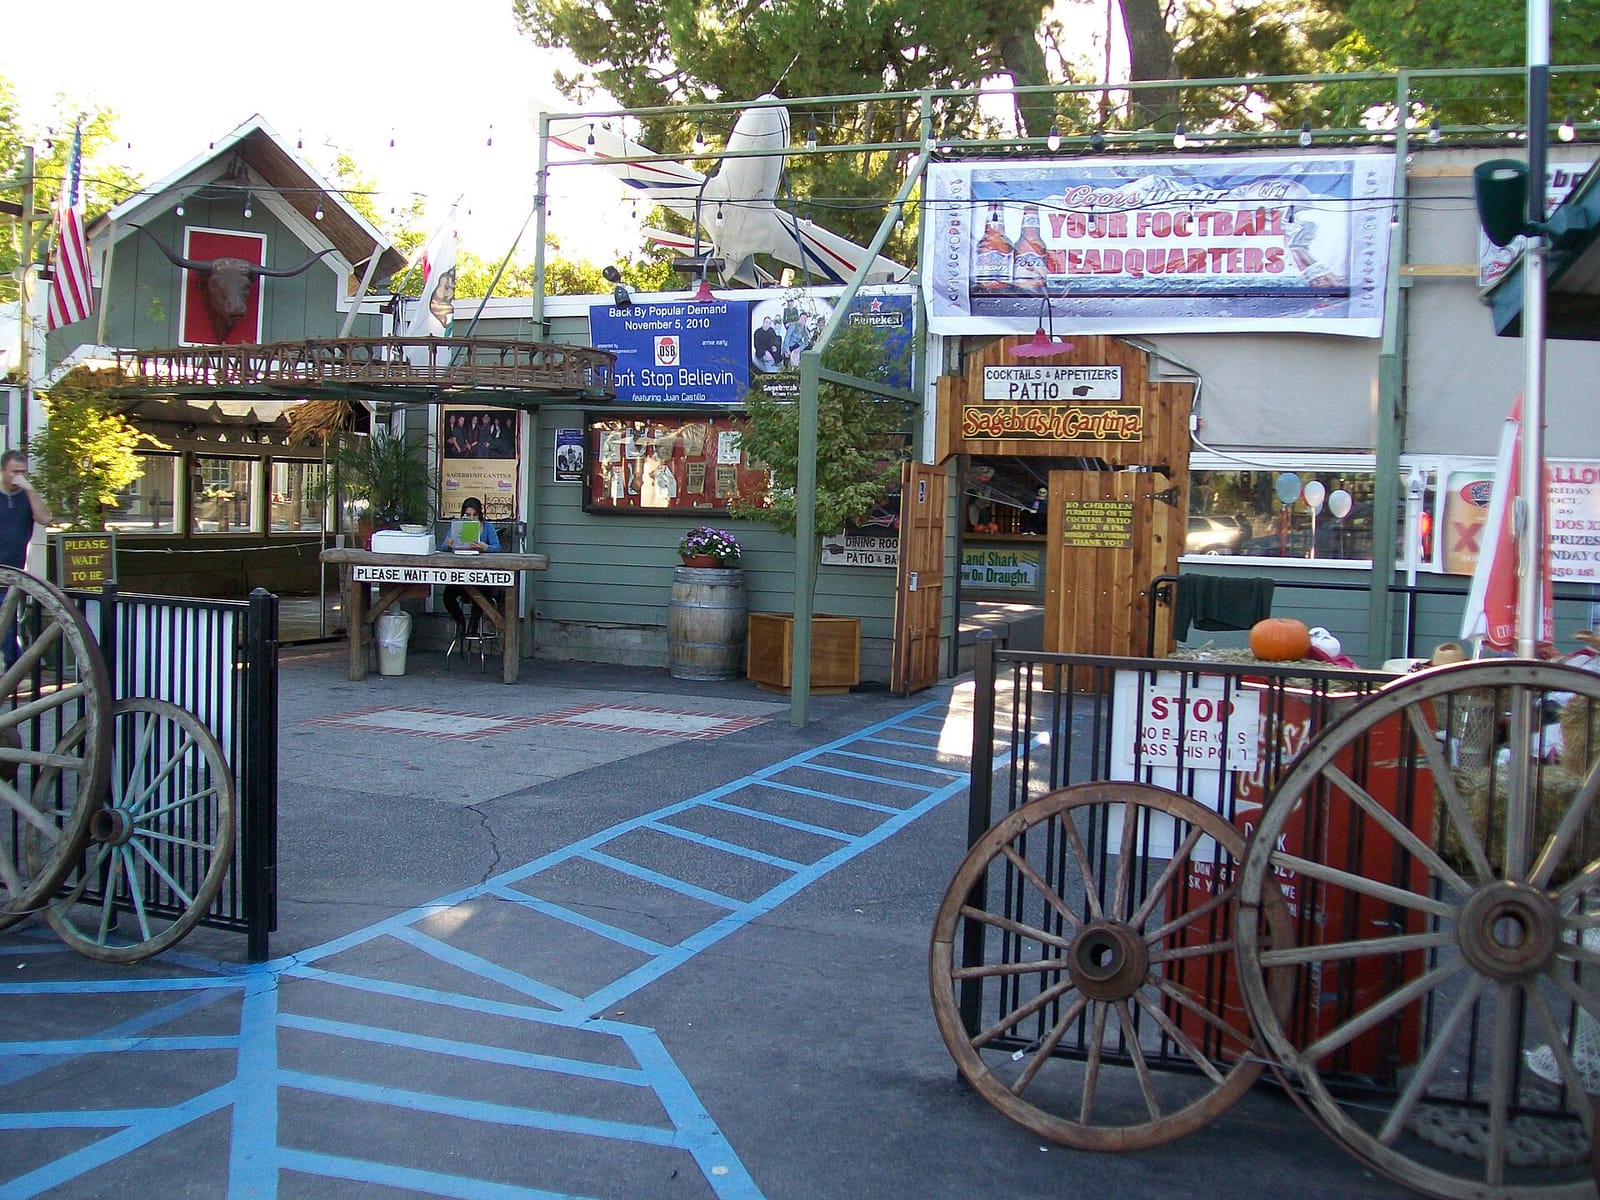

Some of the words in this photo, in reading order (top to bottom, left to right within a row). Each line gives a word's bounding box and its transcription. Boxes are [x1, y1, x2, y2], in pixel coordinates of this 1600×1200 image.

[1064, 185, 1142, 208] Coors
[1140, 188, 1230, 206] LIGHT
[1048, 211, 1128, 239] YOUR
[1136, 209, 1286, 238] FOOTBALL
[1047, 247, 1285, 278] HEADQUARTERS
[609, 307, 632, 318] Back
[634, 307, 647, 318] By
[649, 306, 685, 318] Popular
[688, 304, 727, 315] Demand
[625, 320, 672, 330] November
[674, 320, 684, 330] 5,
[686, 318, 710, 328] 2010
[659, 345, 676, 357] OSB
[641, 368, 674, 391] Stop
[678, 368, 734, 386] Believin
[986, 370, 1041, 380] COCKTAILS
[1054, 370, 1118, 380] APPETIZERS
[632, 392, 661, 402] featuring
[664, 392, 680, 401] Juan
[682, 392, 706, 400] Castillo
[1008, 382, 1059, 399] PATIO
[963, 406, 1062, 438] Sagebrush
[1061, 408, 1143, 439] Cantina
[1547, 487, 1592, 495] RIDAY
[1082, 502, 1132, 510] CHILDREN
[1555, 520, 1584, 530] DOS
[64, 540, 109, 550] PLEASE
[846, 536, 876, 548] DINING
[878, 538, 898, 549] ROO
[71, 554, 104, 566] WAIT
[846, 552, 874, 564] PATIO
[884, 554, 898, 564] BA
[988, 551, 1018, 567] Shark
[1552, 549, 1590, 561] NDAY
[72, 572, 86, 581] TO
[90, 570, 104, 581] BE
[357, 568, 400, 580] PLEASE
[404, 570, 429, 582] WAIT
[432, 570, 447, 582] TO
[451, 571, 465, 582] BE
[468, 572, 511, 584] SEATED
[972, 568, 984, 582] On
[986, 568, 1031, 587] Draught.
[1151, 696, 1235, 722] STOP
[1139, 727, 1157, 740] NO
[1162, 728, 1246, 745] BVERS
[1173, 744, 1204, 759] THIS
